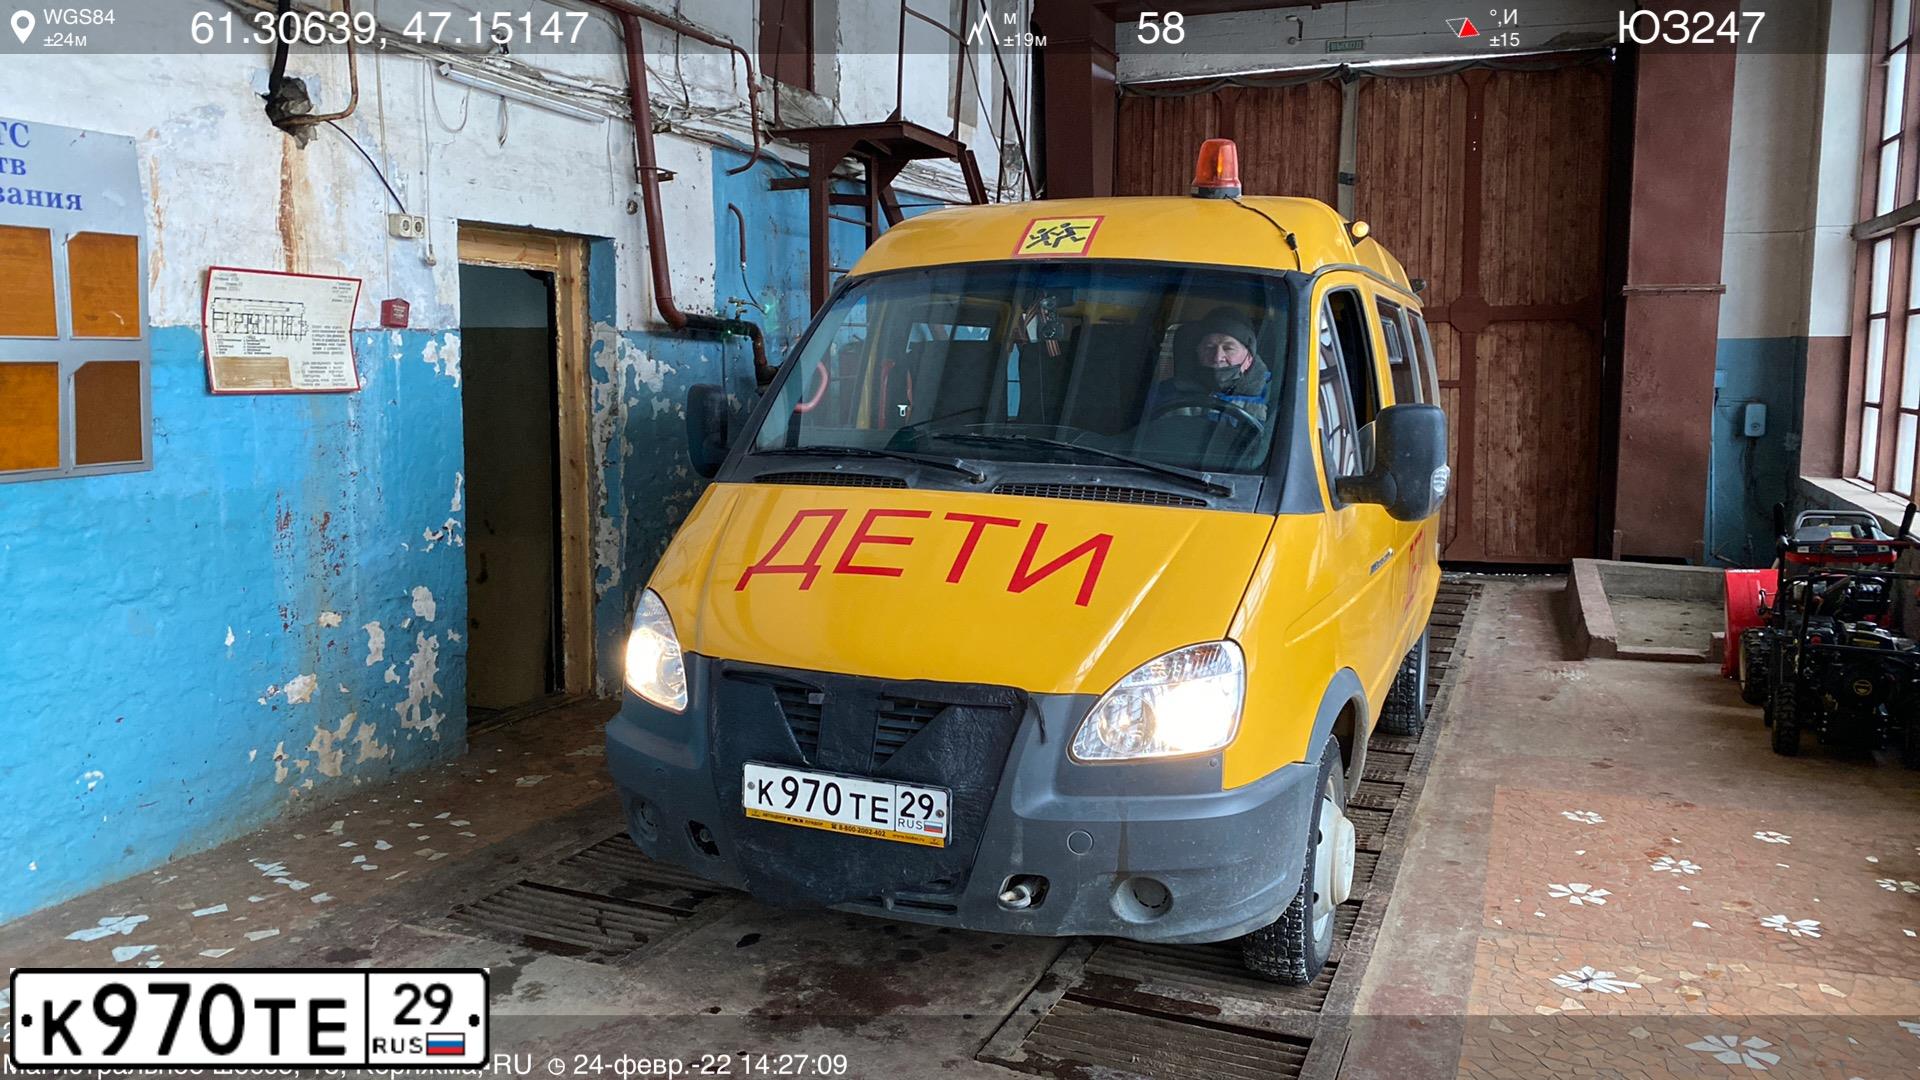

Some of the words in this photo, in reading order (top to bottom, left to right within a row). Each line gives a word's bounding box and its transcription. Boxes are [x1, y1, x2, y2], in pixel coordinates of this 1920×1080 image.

[734, 508, 1114, 608] ДЕТИ
[899, 790, 935, 820] 29
[896, 816, 924, 831] RUS
